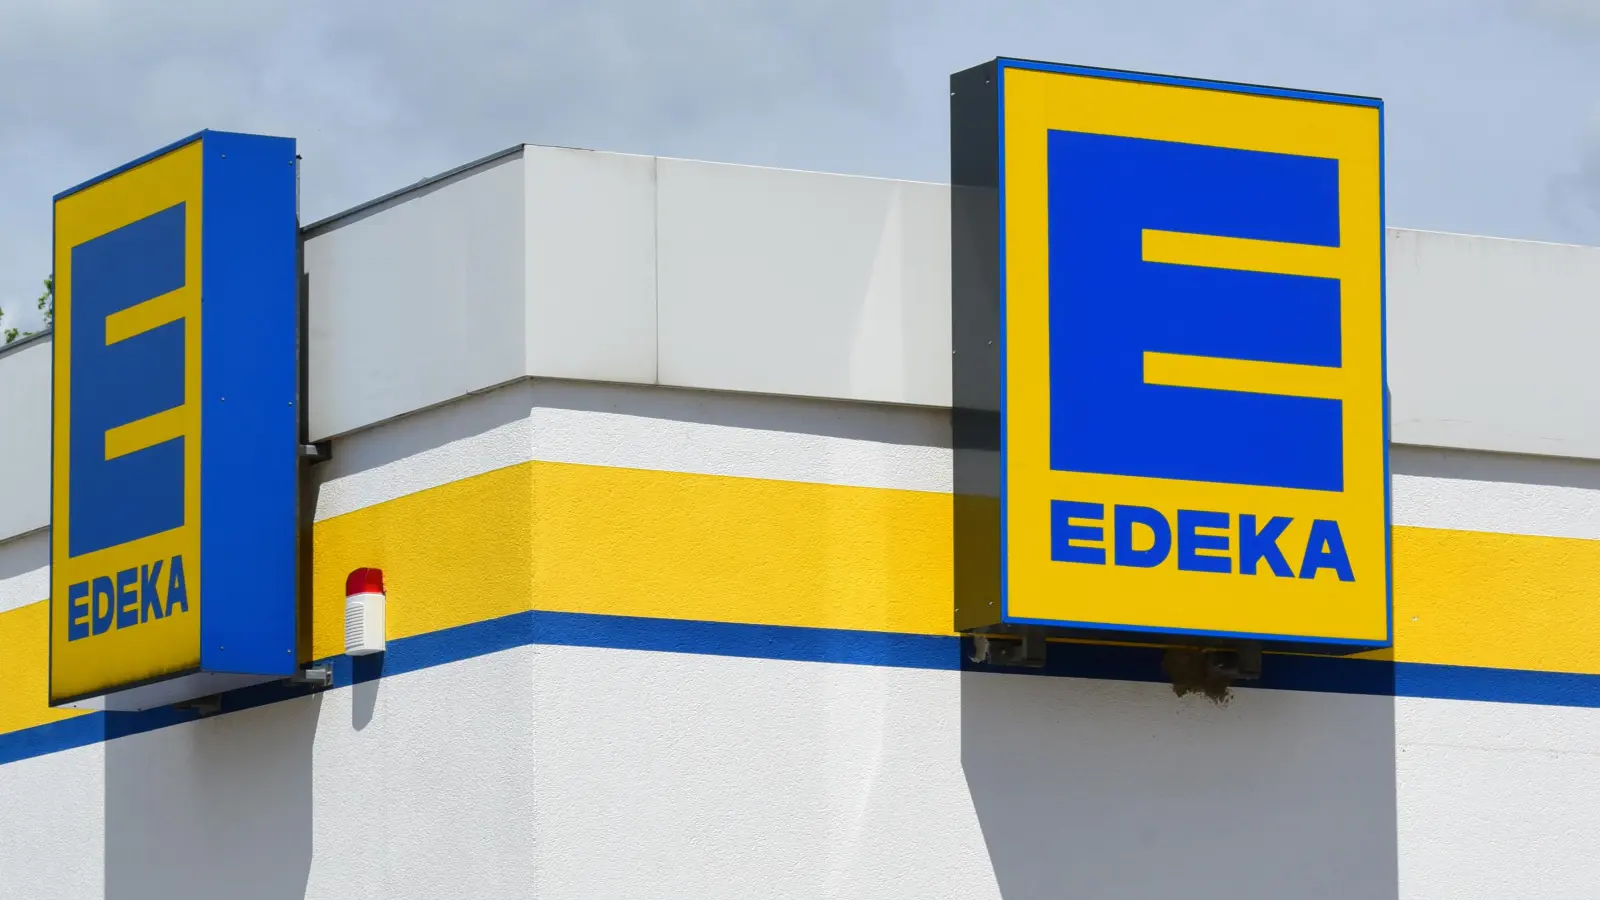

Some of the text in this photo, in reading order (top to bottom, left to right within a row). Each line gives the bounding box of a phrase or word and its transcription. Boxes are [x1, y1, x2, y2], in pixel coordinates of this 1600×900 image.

[69, 202, 186, 558] E
[1047, 129, 1343, 492] E
[68, 555, 188, 641] EDEKA
[1050, 500, 1355, 582] EDEKA
